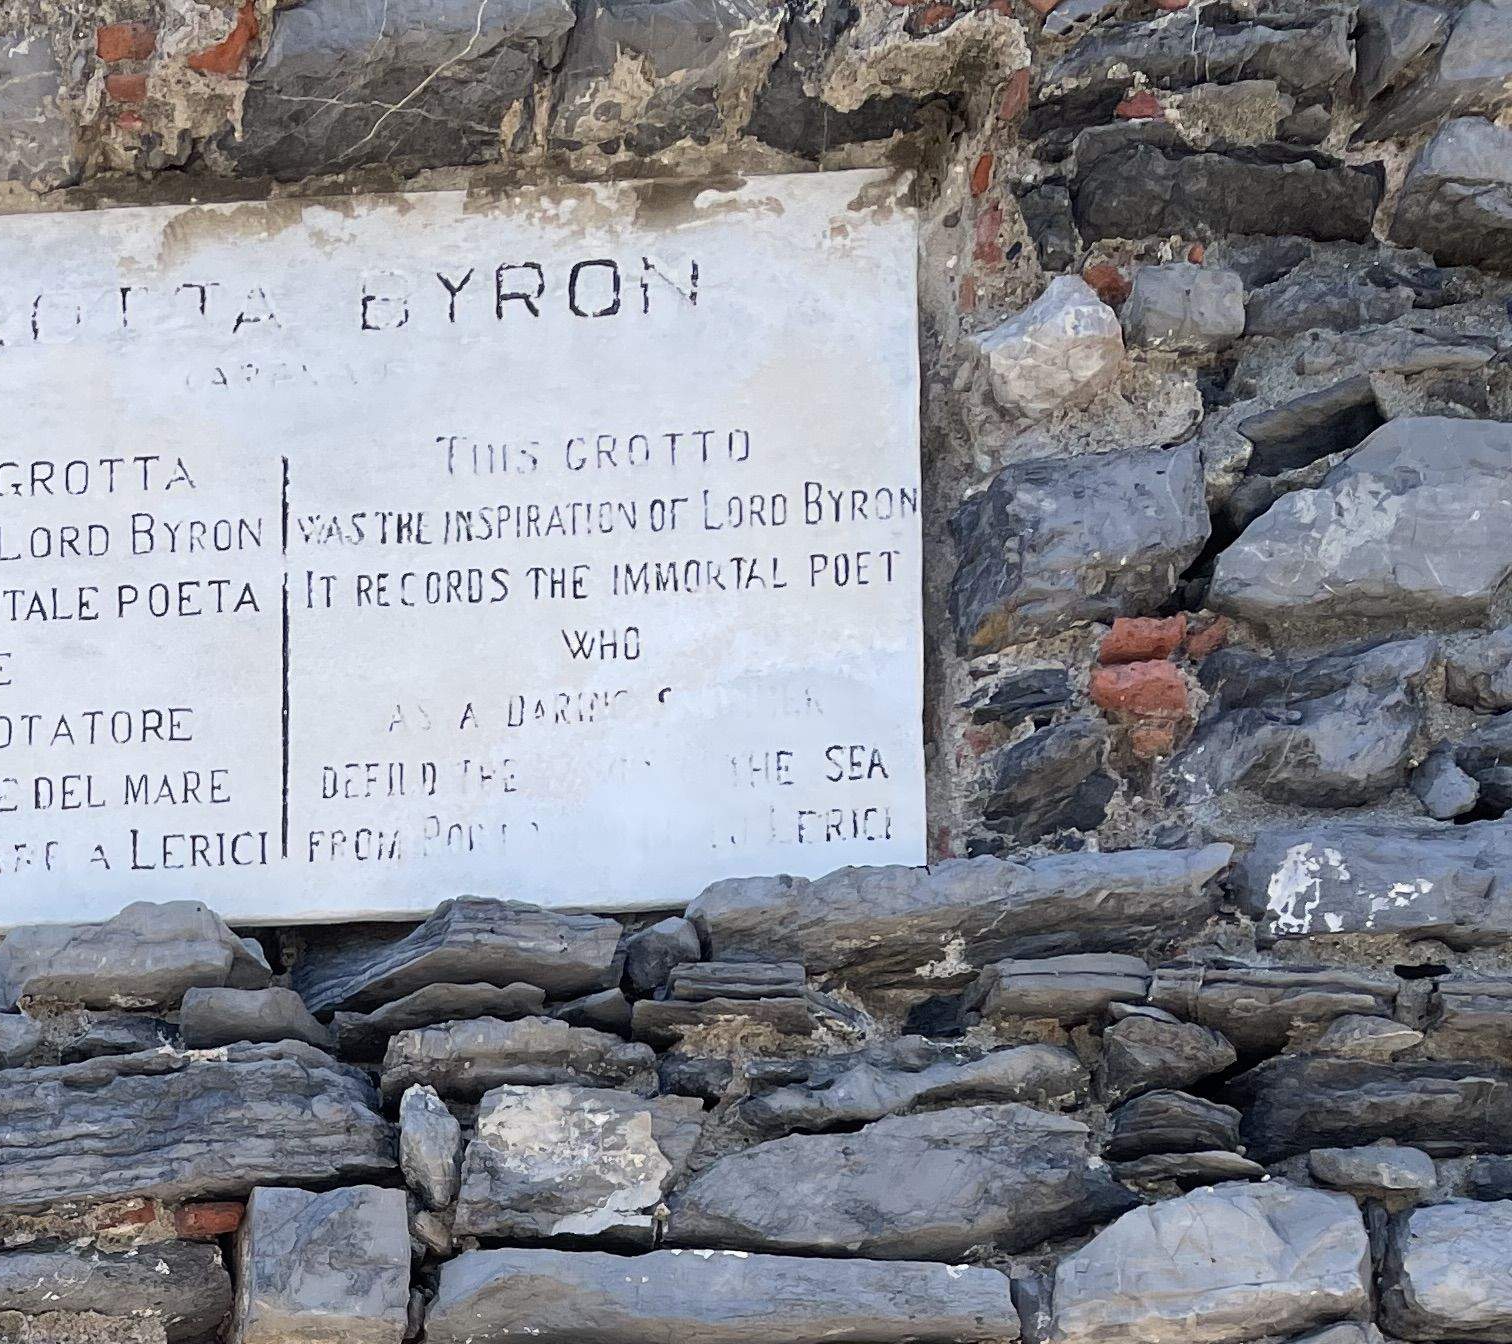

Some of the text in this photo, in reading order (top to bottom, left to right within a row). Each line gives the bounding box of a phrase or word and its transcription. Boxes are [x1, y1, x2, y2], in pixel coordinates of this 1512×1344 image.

[361, 256, 701, 332] BYRON
[565, 429, 752, 471] GROTTO
[131, 512, 263, 555] BYRON
[297, 481, 918, 545] WAS THE INSPIRATION OF LORD BYRON
[117, 578, 261, 619] POETA
[306, 550, 902, 608] IT RECORDS THE IMMORTAL POET
[561, 626, 640, 660] WHO
[459, 703, 479, 730] A
[507, 690, 629, 728] DARIN
[824, 744, 890, 783] SEA
[34, 774, 107, 810] DEL
[124, 769, 231, 806] MARE
[131, 828, 270, 870] LERICI
